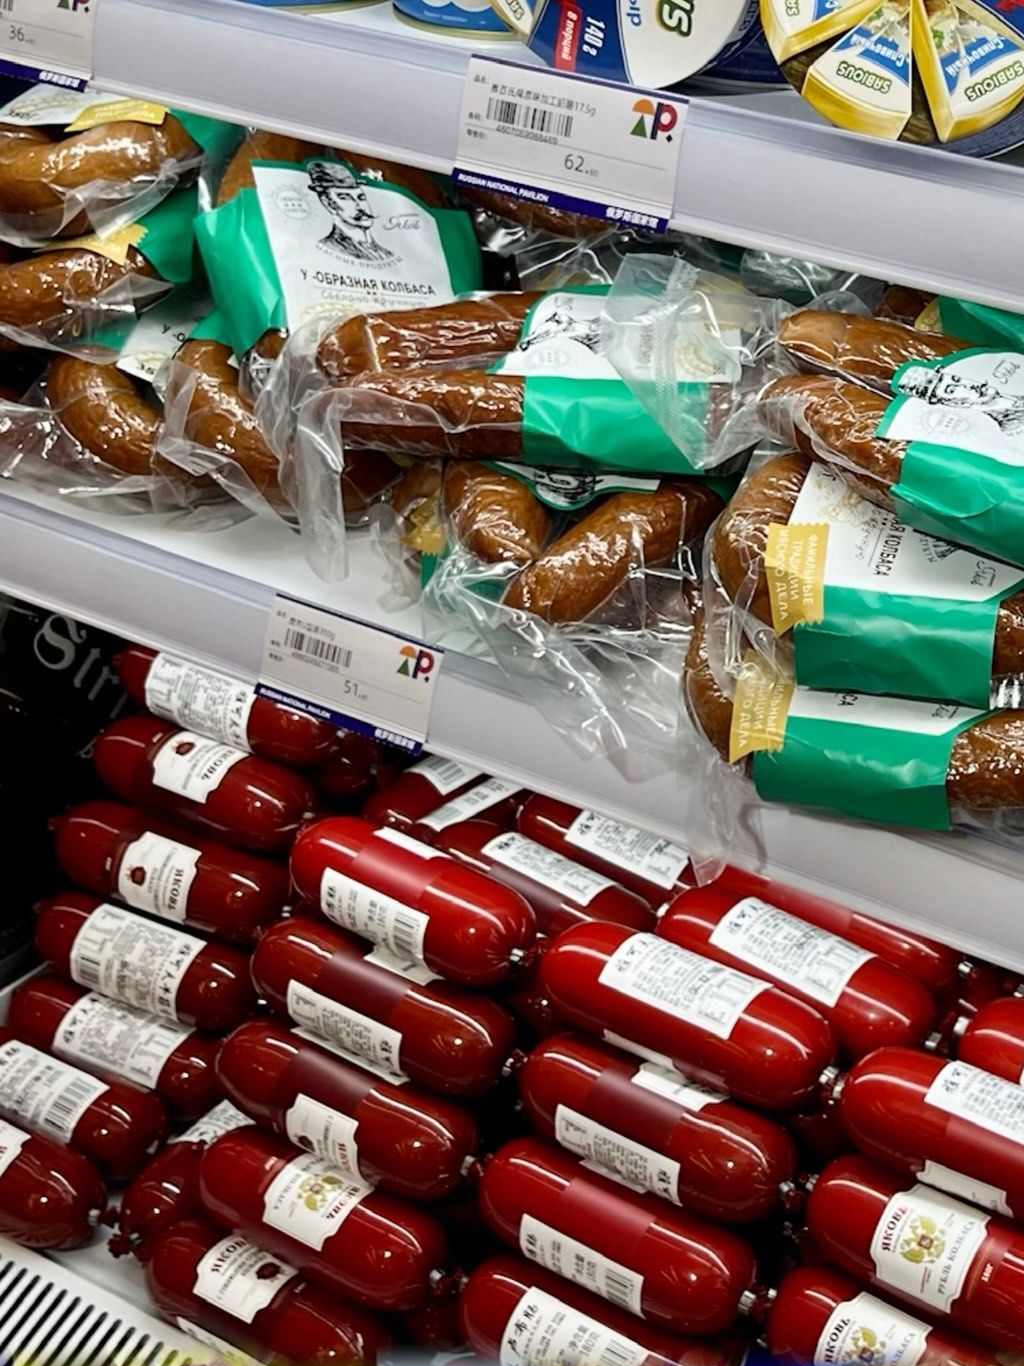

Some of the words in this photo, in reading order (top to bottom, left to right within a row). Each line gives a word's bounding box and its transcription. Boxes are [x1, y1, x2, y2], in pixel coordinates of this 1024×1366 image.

[836, 61, 892, 95] SABIOUS
[458, 173, 487, 187] RUSSIAN
[487, 179, 519, 196] NATIONAL
[519, 187, 549, 203] PAVILION
[381, 280, 437, 297] КОЛБАСА
[803, 533, 819, 607] ФАМИЛЬНЫЕ
[872, 529, 905, 577] КОЛБАСА
[774, 579, 790, 621] ДЕЛА
